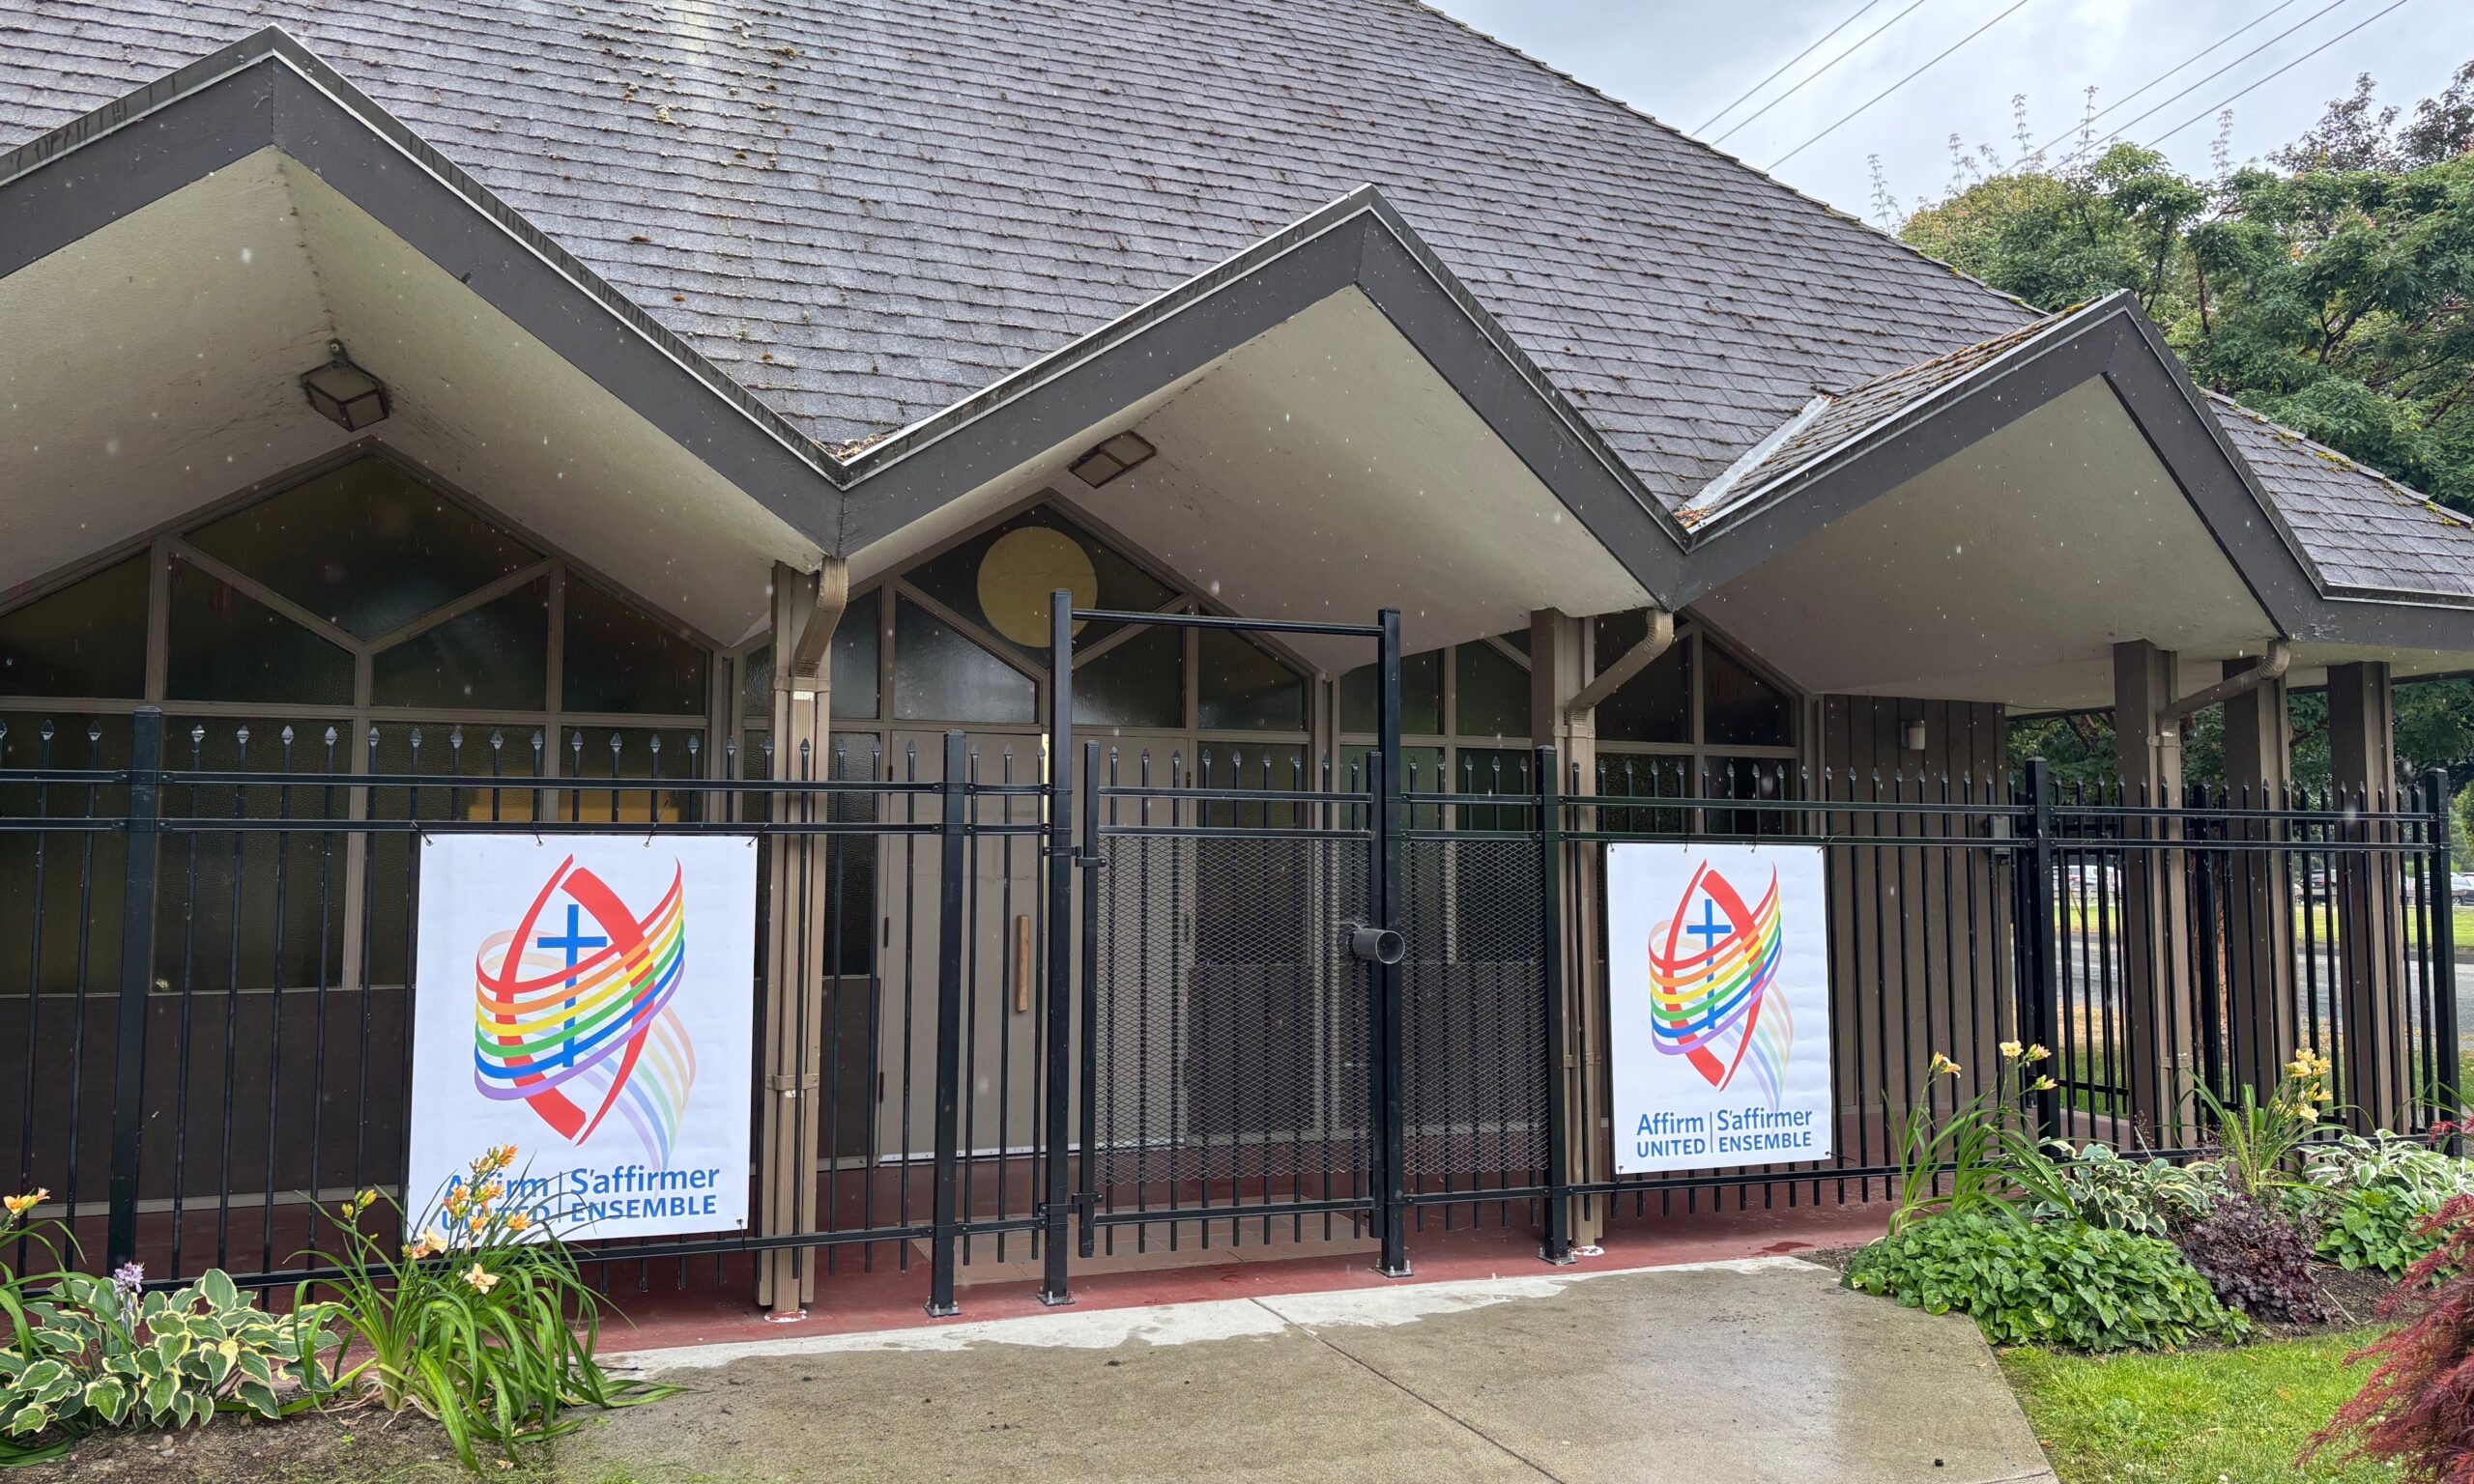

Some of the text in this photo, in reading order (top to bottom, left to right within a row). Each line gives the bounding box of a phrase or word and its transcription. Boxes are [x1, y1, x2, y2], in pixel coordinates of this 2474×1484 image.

[1636, 1107, 1813, 1136] Affirm S'affirmer
[1636, 1131, 1812, 1158] UNITED ENSEMBLE
[444, 1164, 720, 1202] Airm S'affirmer
[571, 1194, 716, 1223] ENSEMBLE
